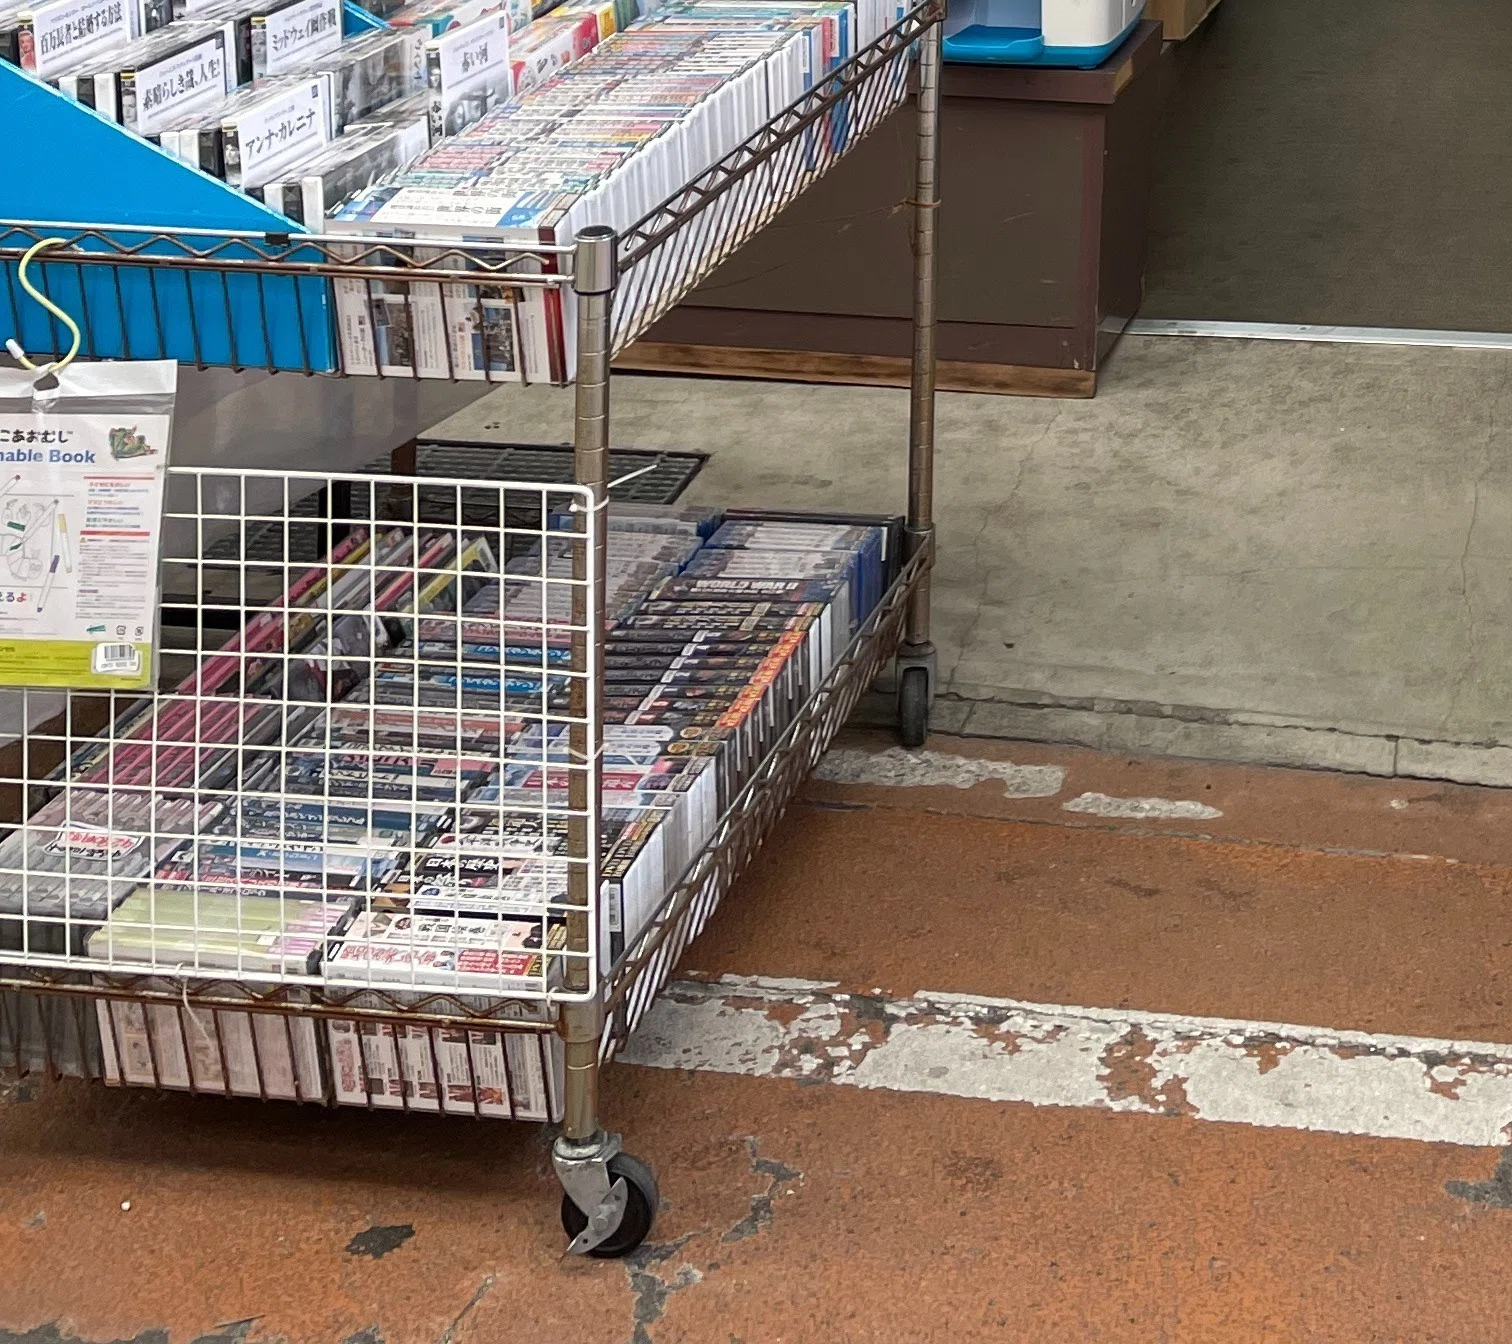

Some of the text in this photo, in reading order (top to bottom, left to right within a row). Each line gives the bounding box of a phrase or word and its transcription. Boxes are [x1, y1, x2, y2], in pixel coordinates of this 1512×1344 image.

[245, 106, 317, 158] アンナ・カレニナ
[49, 448, 96, 464] Book
